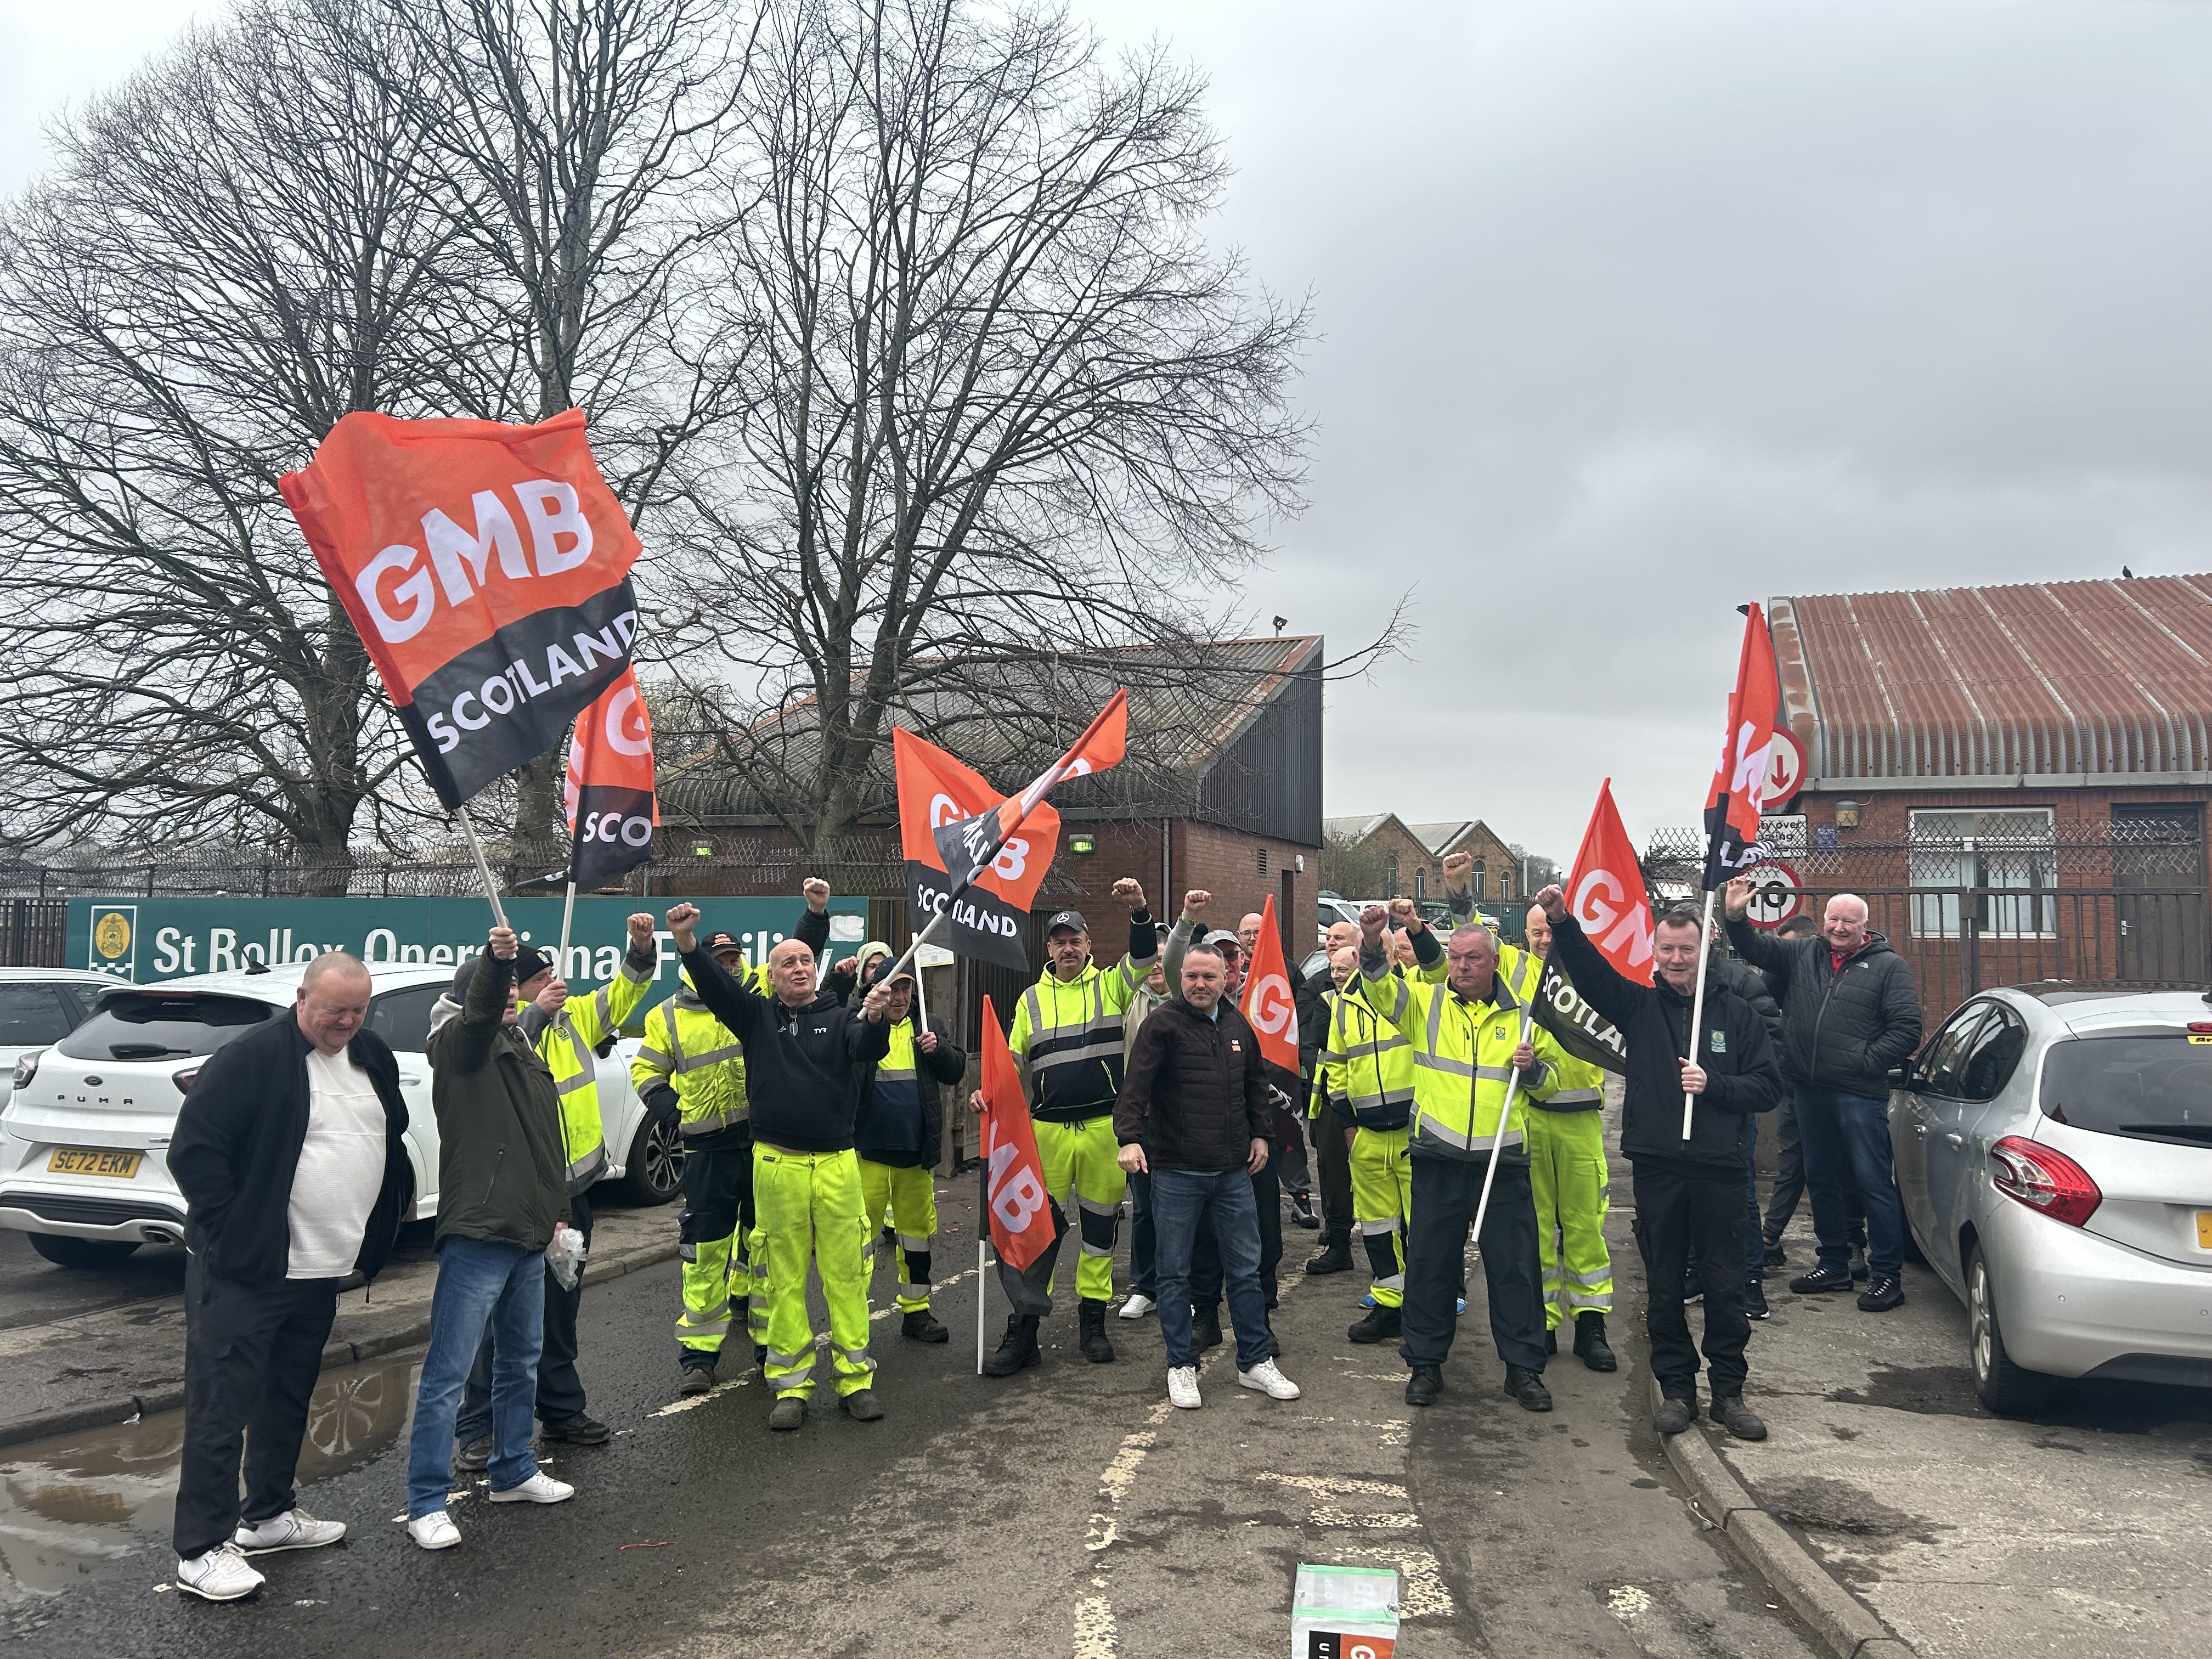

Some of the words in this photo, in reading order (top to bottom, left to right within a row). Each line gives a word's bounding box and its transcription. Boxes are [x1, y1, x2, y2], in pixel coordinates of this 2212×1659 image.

[356, 479, 594, 644] GMB
[426, 610, 639, 754] SCOTLAND
[154, 927, 196, 973] St
[58, 1095, 133, 1104] PUMA
[55, 1151, 98, 1171] SC72
[98, 1154, 134, 1173] EKM
